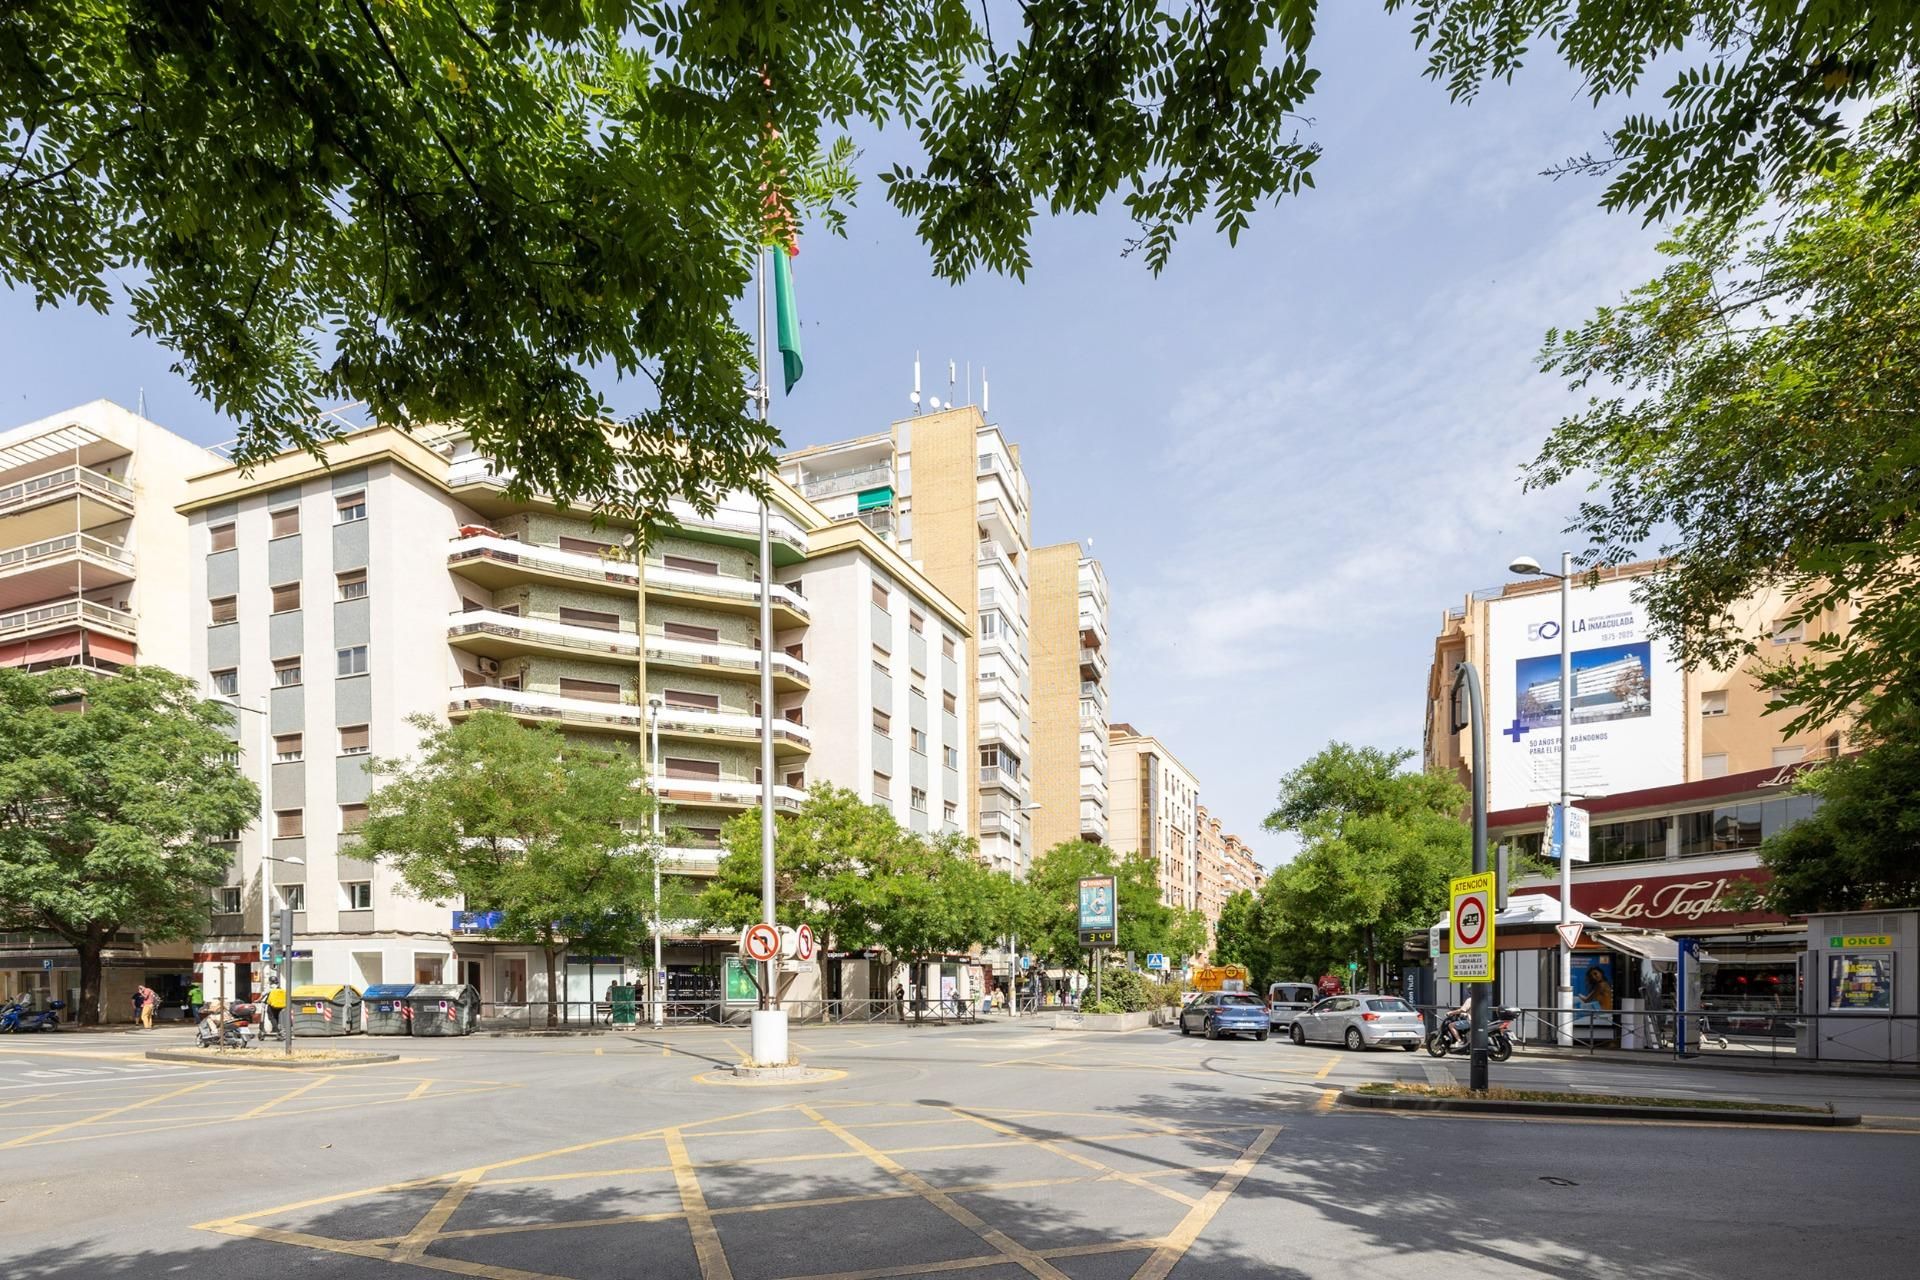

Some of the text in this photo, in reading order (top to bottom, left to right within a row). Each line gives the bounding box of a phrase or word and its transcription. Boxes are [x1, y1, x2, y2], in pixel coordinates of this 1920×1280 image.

[1572, 619, 1586, 633] LA
[1588, 617, 1634, 631] INMACULADA
[1529, 739, 1538, 747] 50
[1539, 738, 1555, 746] AÑOS
[1529, 747, 1545, 755] PARA
[1756, 764, 1791, 788] La
[1455, 878, 1488, 892] ATENCIÓN
[1590, 884, 1643, 920] La
[1848, 937, 1886, 945] ONCE
